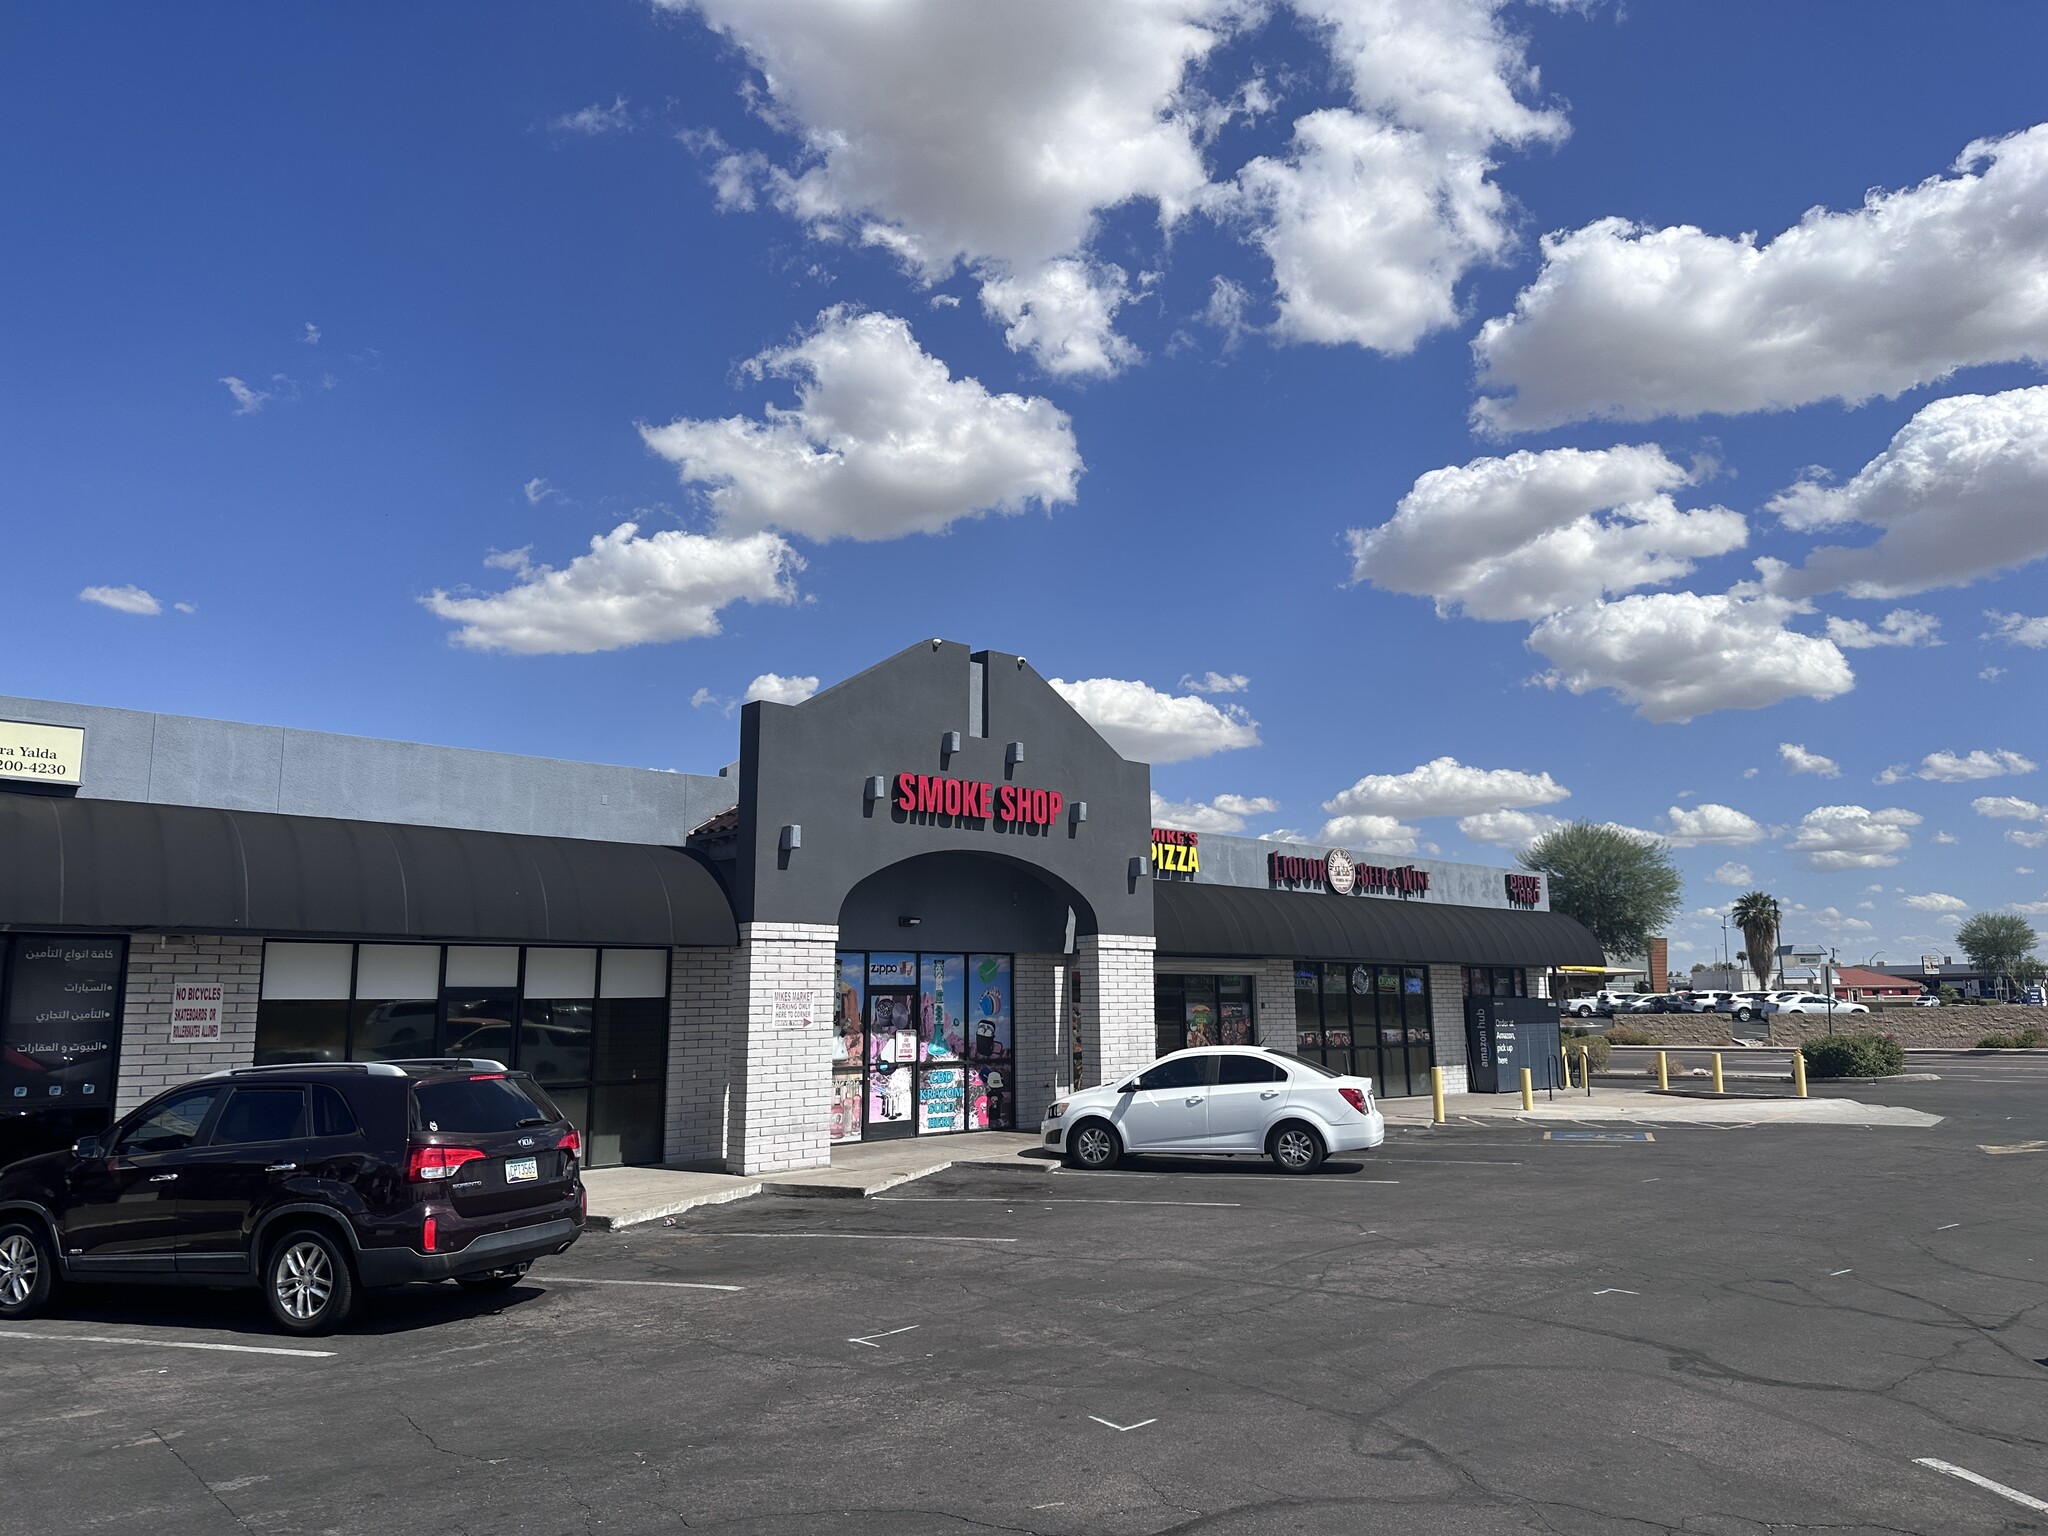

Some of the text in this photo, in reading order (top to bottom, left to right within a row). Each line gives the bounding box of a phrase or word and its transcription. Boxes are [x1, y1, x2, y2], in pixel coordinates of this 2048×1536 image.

[20, 746, 57, 759] Yalda
[898, 772, 1063, 825] SMOKE SHOP
[1273, 850, 1431, 892] LIQUOR BEER & WINE
[1510, 874, 1541, 889] DRIVE
[1512, 889, 1541, 904] THRU
[25, 946, 113, 961] كافة انواع التأمين
[64, 983, 107, 993] السيارات
[176, 987, 221, 1000] NO BICYCLES
[774, 991, 814, 1001] MIKES MARKET
[36, 1008, 104, 1023] التأمين التجاري
[174, 1008, 216, 1021] SKATEBOARDS OR
[794, 1010, 811, 1018] CORNER
[1495, 1019, 1508, 1027] Order
[173, 1024, 218, 1038] ROLLERSKATES ALLOWED
[1476, 1008, 1489, 1068] amazon hub
[17, 1042, 101, 1054] البيوت و العقارات
[1497, 1043, 1514, 1053] pick up
[1497, 1056, 1508, 1064] here
[929, 1070, 954, 1084] CBD
[919, 1086, 964, 1100] KRATOM
[927, 1101, 956, 1115] SOLD
[927, 1115, 955, 1129] HERE
